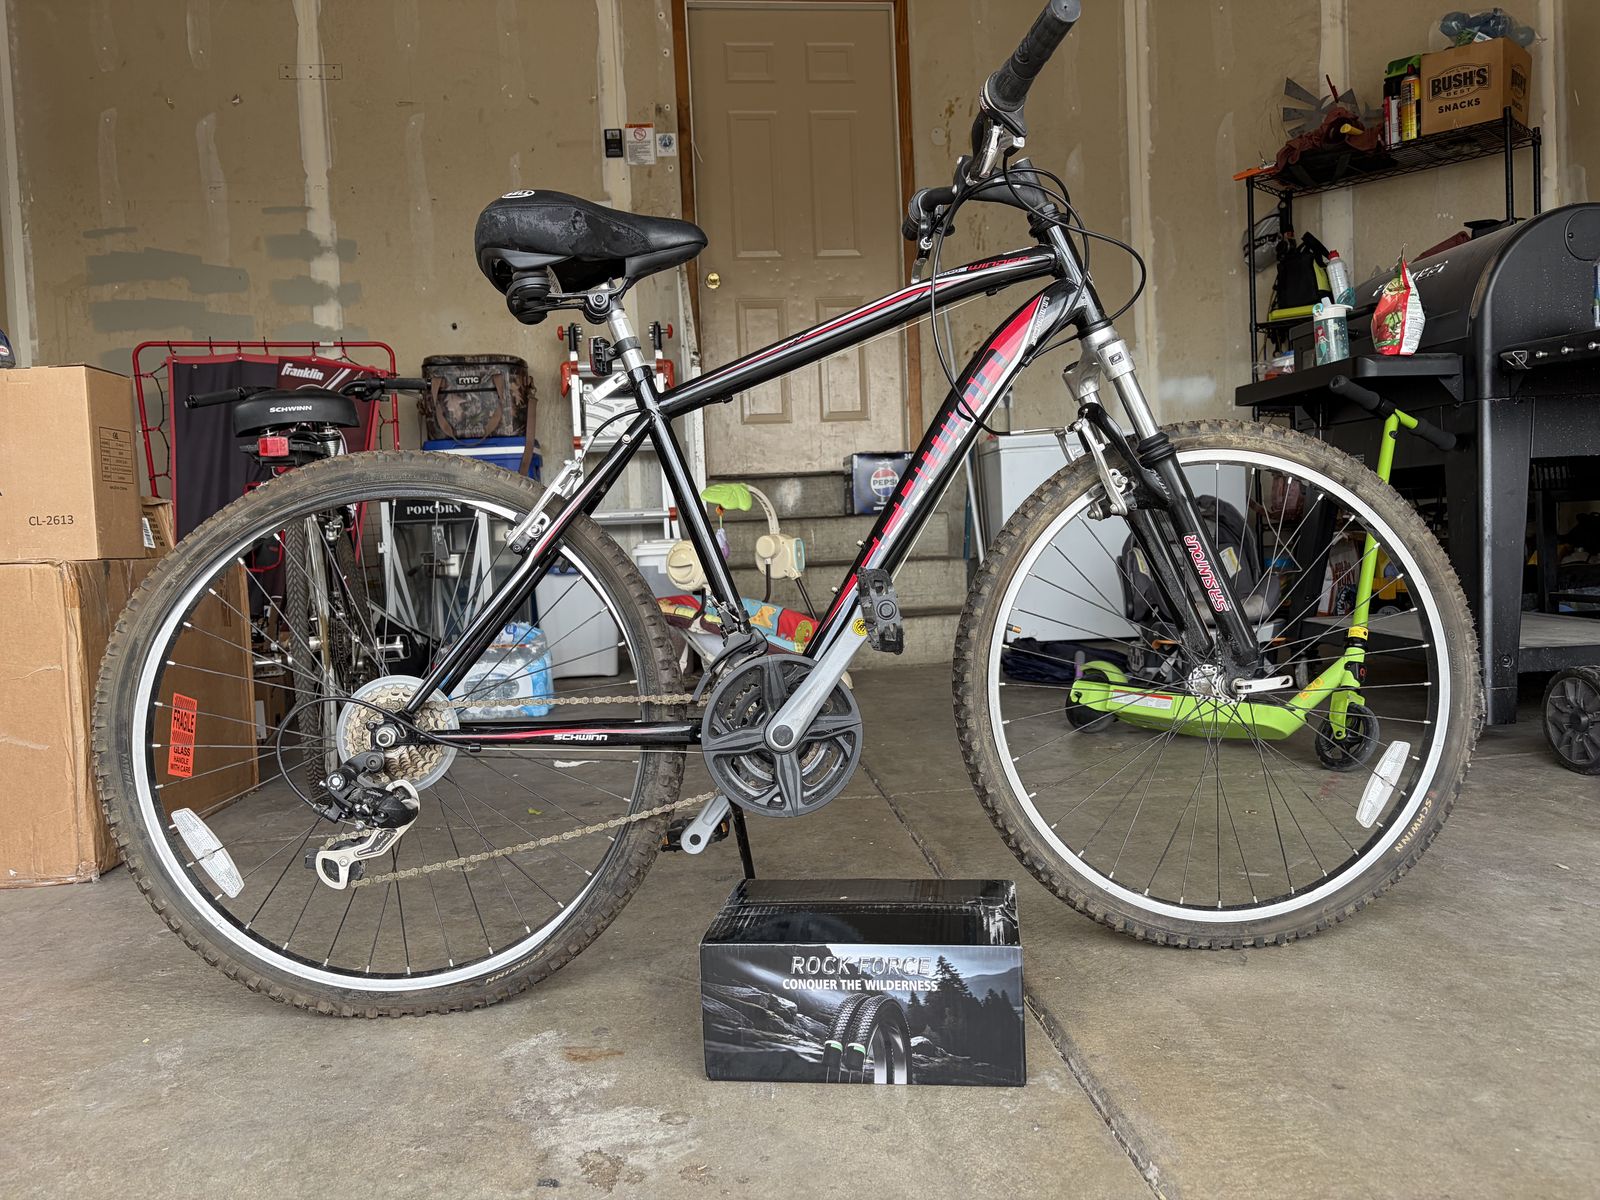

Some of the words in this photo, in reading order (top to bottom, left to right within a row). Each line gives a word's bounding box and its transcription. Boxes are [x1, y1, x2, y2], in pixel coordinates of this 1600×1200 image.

[1432, 68, 1487, 96] BUSH'S
[1446, 88, 1472, 97] BEST
[1438, 98, 1481, 114] SNACKS
[281, 363, 324, 381] Franklin
[269, 405, 312, 413] SCHWINN
[406, 504, 461, 515] POPCORN
[28, 515, 74, 526] CL-2613
[1184, 534, 1219, 589] SUNTOUR
[173, 709, 194, 733] FRAGILE
[553, 733, 608, 741] SCHWINN
[173, 746, 191, 757] GLASS
[173, 755, 189, 765] HANDLE
[180, 765, 191, 774] CARE
[1394, 797, 1433, 853] SCHWINN
[790, 955, 852, 975] ROCK
[857, 956, 932, 976] FORCE
[782, 978, 838, 991] CONQUER
[840, 978, 862, 991] THE
[864, 979, 938, 992] WILDERNESS
